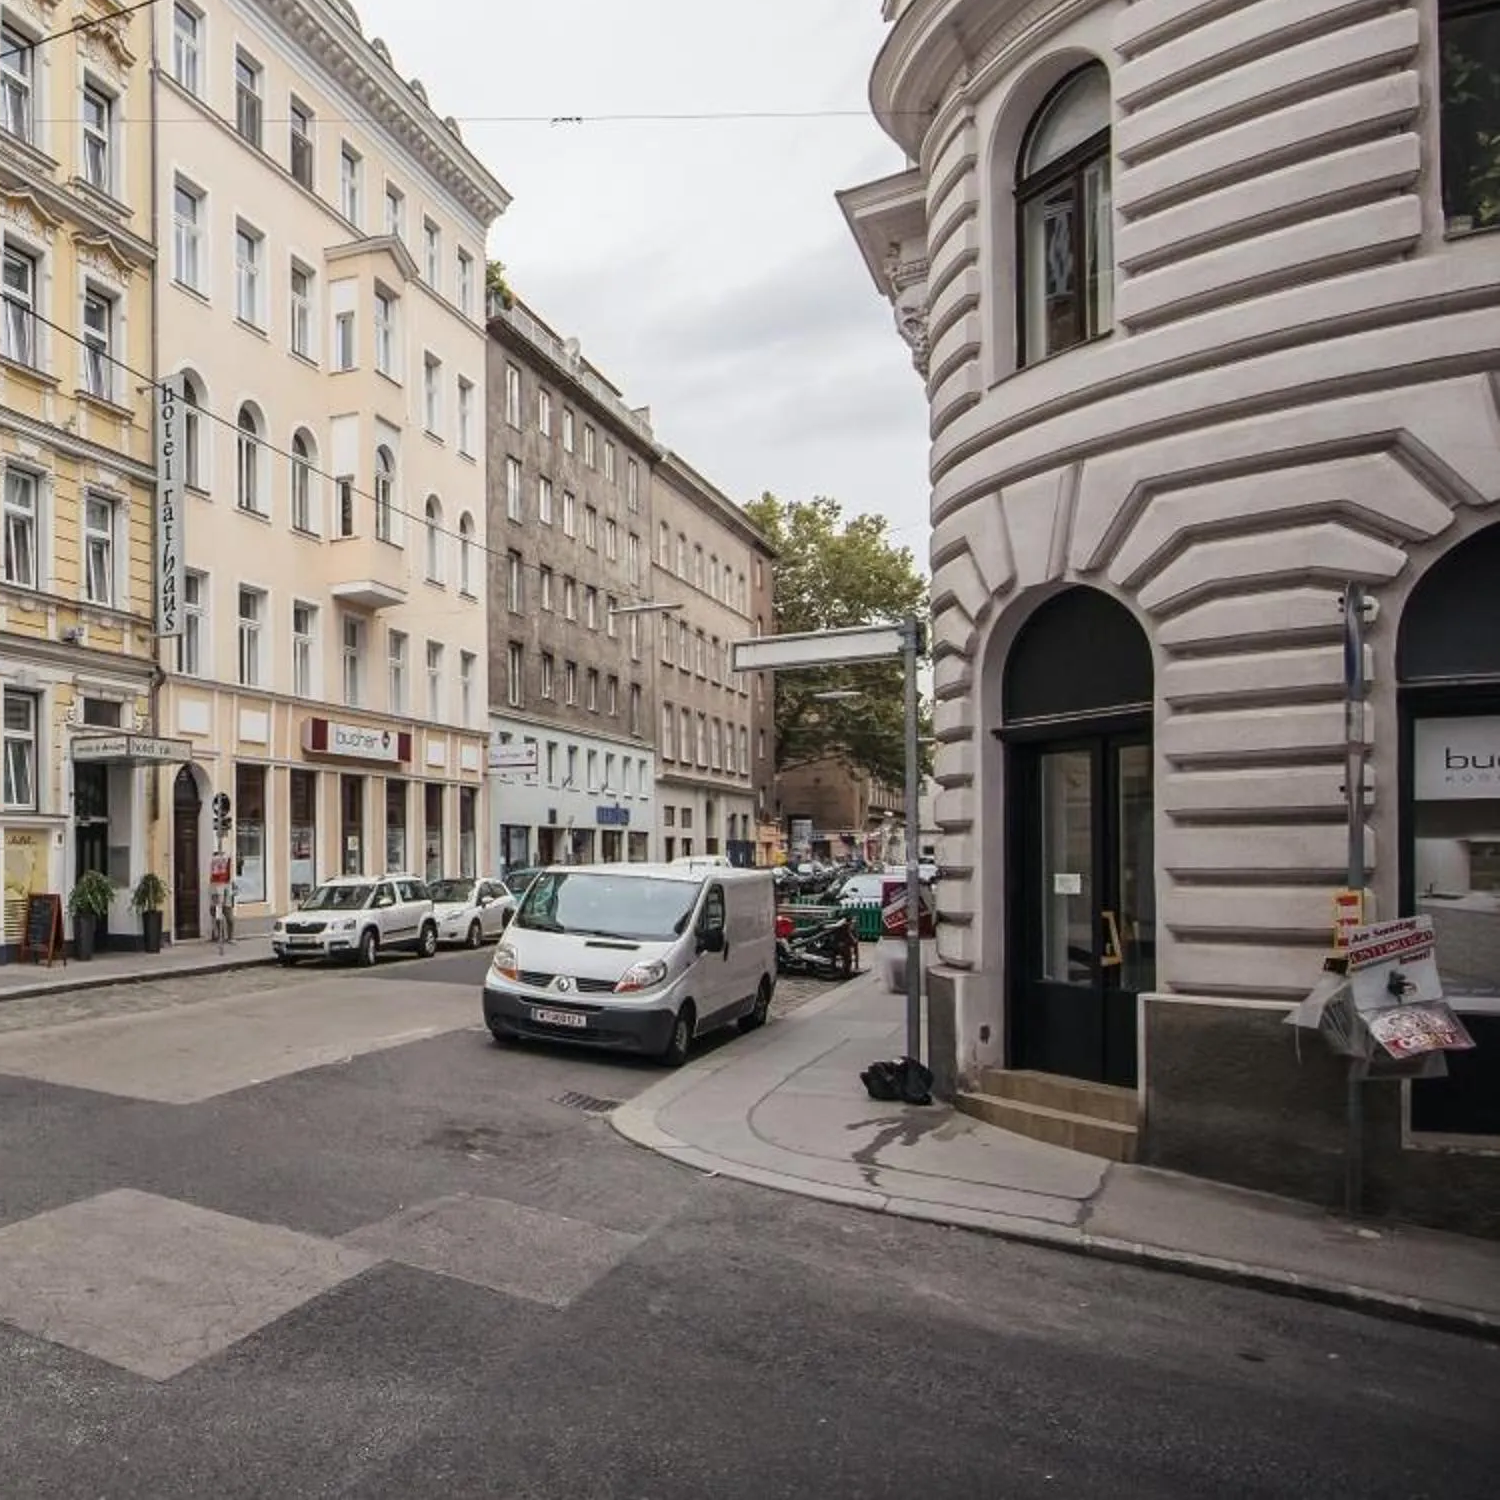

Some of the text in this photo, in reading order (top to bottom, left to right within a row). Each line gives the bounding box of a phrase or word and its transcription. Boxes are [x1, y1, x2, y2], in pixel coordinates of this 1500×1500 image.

[162, 382, 176, 632] hotel rathaus
[1445, 746, 1500, 769] bu
[1372, 919, 1417, 938] Sonntag
